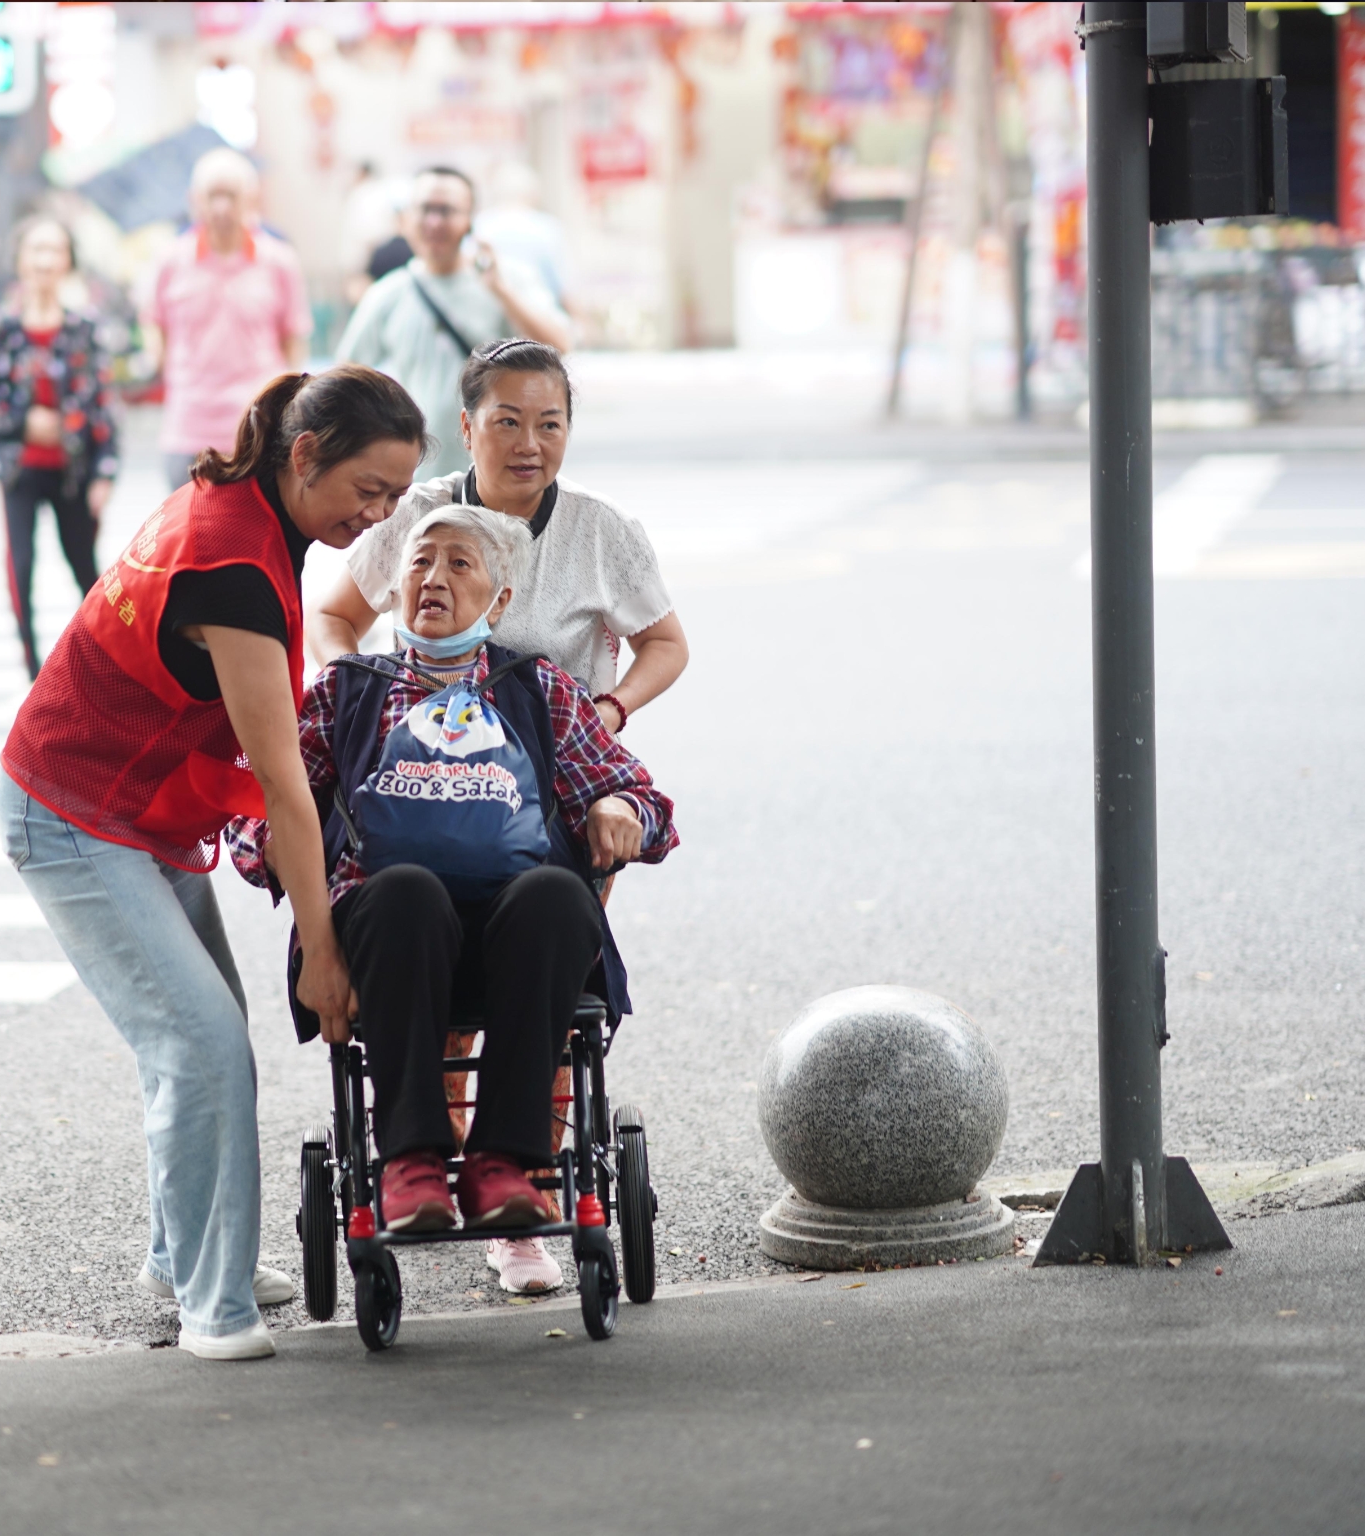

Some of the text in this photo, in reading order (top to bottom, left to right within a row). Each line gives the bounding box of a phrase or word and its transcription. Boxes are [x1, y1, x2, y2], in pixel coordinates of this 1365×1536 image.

[397, 761, 516, 787] VINPEARL LAND
[429, 780, 444, 797] &
